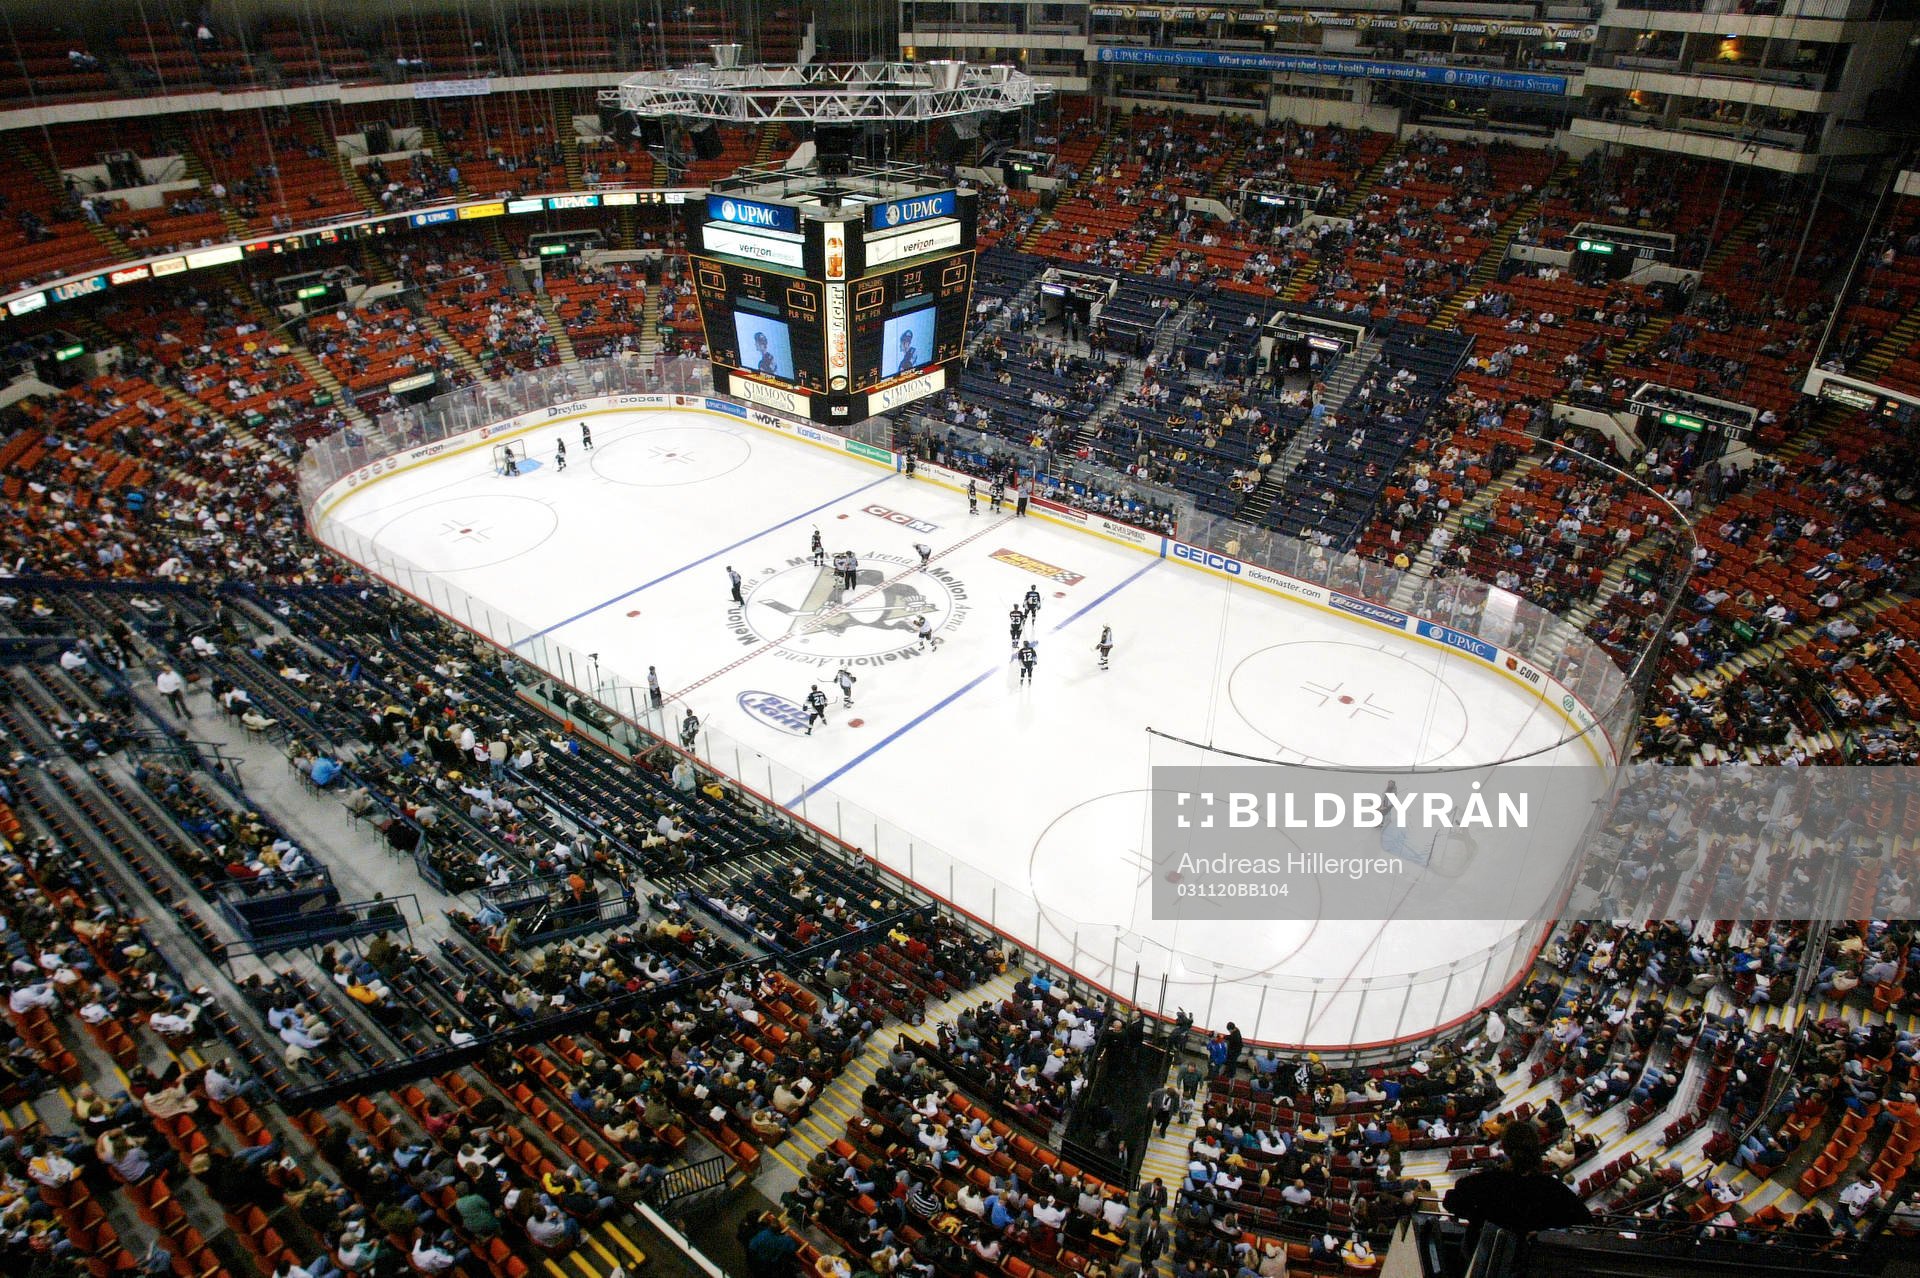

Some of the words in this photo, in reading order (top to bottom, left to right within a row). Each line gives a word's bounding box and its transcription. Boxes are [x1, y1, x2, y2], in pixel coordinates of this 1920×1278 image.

[1114, 51, 1142, 61] UPMC
[1218, 56, 1239, 65] What
[1241, 58, 1257, 67] you
[1318, 63, 1337, 72] your
[1338, 62, 1364, 73] health
[1366, 64, 1385, 75] plan
[1387, 67, 1414, 77] would
[1459, 73, 1490, 85] UPMC
[553, 196, 594, 209] UPMC
[902, 198, 942, 220] UPMC
[738, 204, 780, 227] UPMC
[739, 243, 772, 257] verizon
[903, 237, 934, 253] verizon
[55, 277, 101, 300] UPMC
[620, 396, 664, 404] DODGE
[743, 381, 796, 412] SIMMONS
[882, 375, 932, 409] SIMMONS
[547, 402, 588, 418] Dreyfus
[754, 412, 781, 428] WDVE
[410, 443, 444, 460] verizon
[864, 505, 937, 533] CCM
[862, 551, 914, 564] Arena
[1173, 543, 1242, 575] GEICO
[928, 567, 968, 601] Mellon
[1248, 569, 1321, 599] ticketmaster.com
[946, 603, 974, 632] Arena
[1364, 607, 1405, 623] LIGHT
[726, 608, 761, 646] Mellon
[1447, 634, 1486, 656] UPMC
[773, 650, 833, 668] Arena
